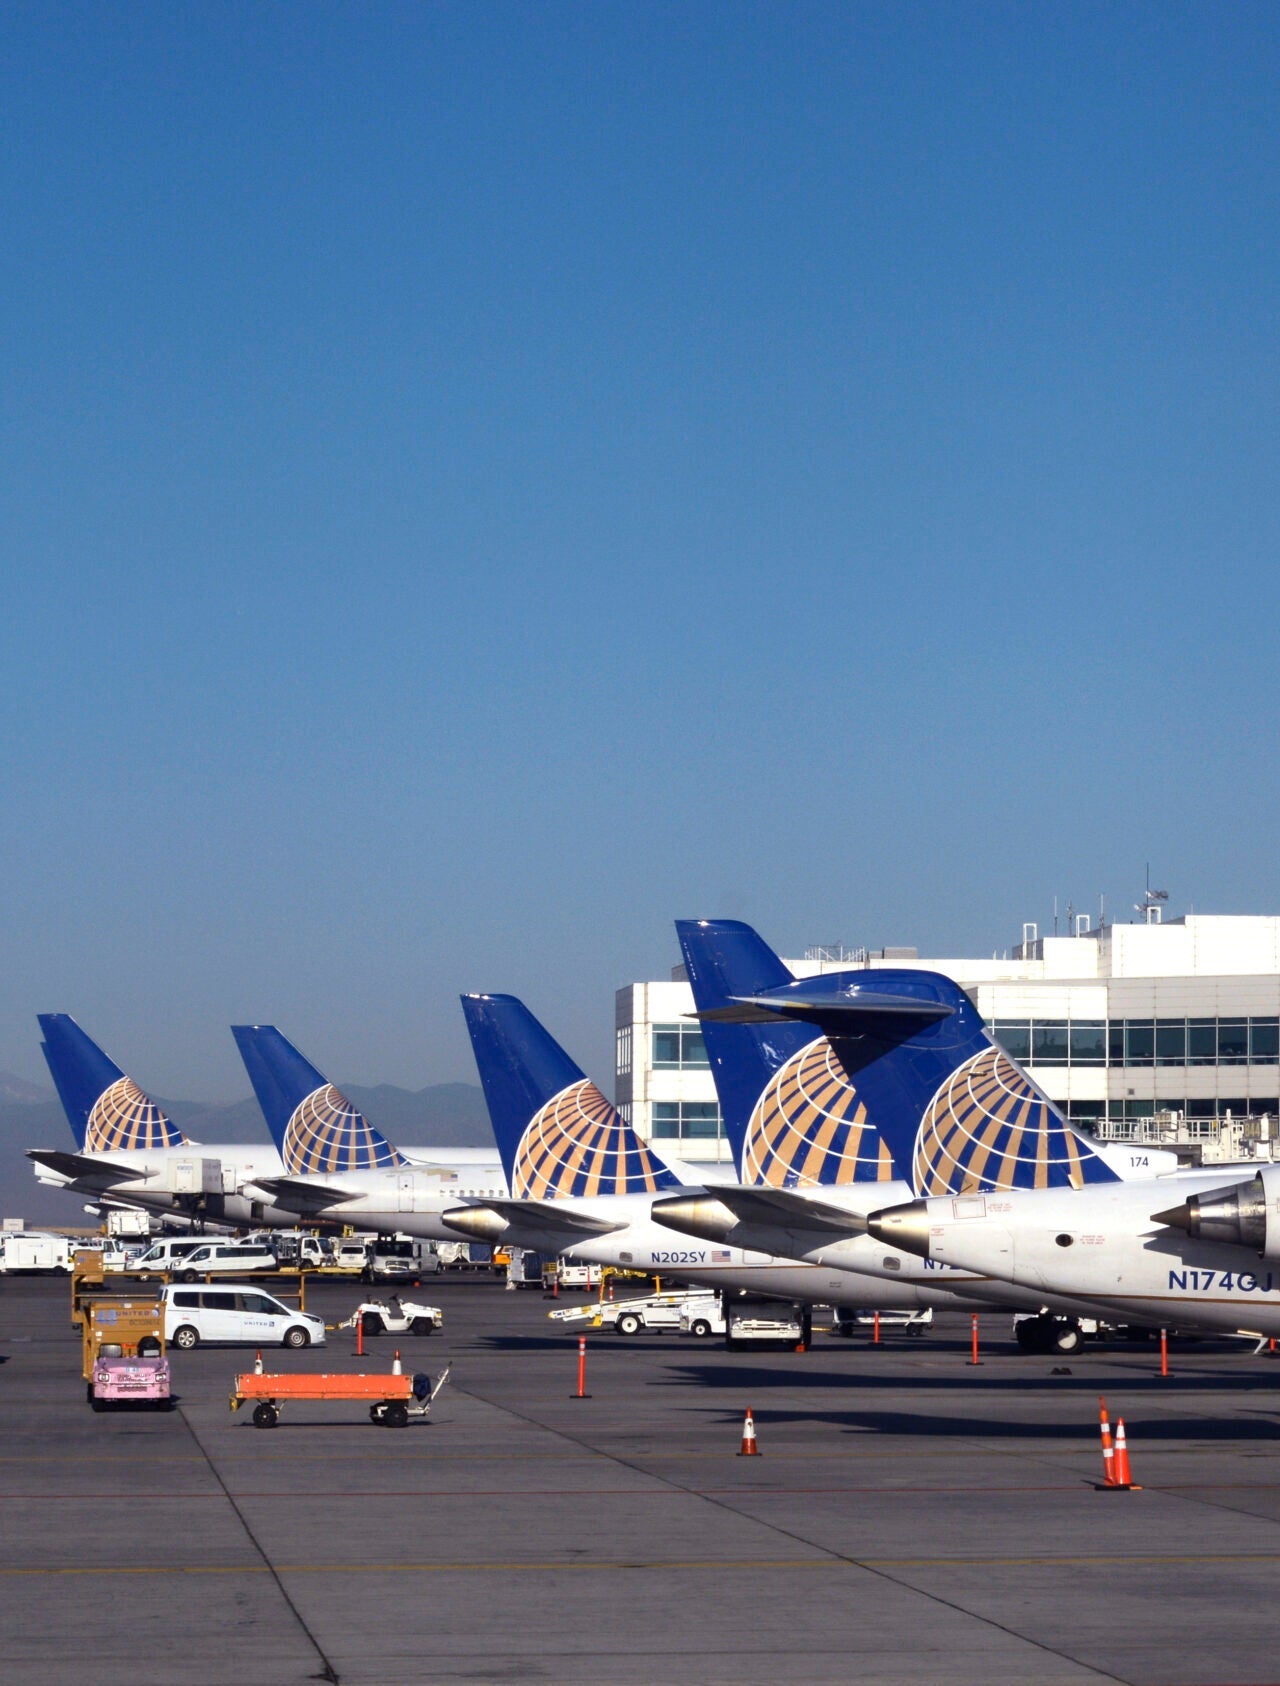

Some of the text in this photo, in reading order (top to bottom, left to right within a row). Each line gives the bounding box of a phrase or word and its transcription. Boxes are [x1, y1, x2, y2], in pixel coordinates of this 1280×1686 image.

[1130, 1157, 1149, 1167] 174
[651, 1251, 706, 1263] N202SY
[1168, 1270, 1273, 1292] N174GJ
